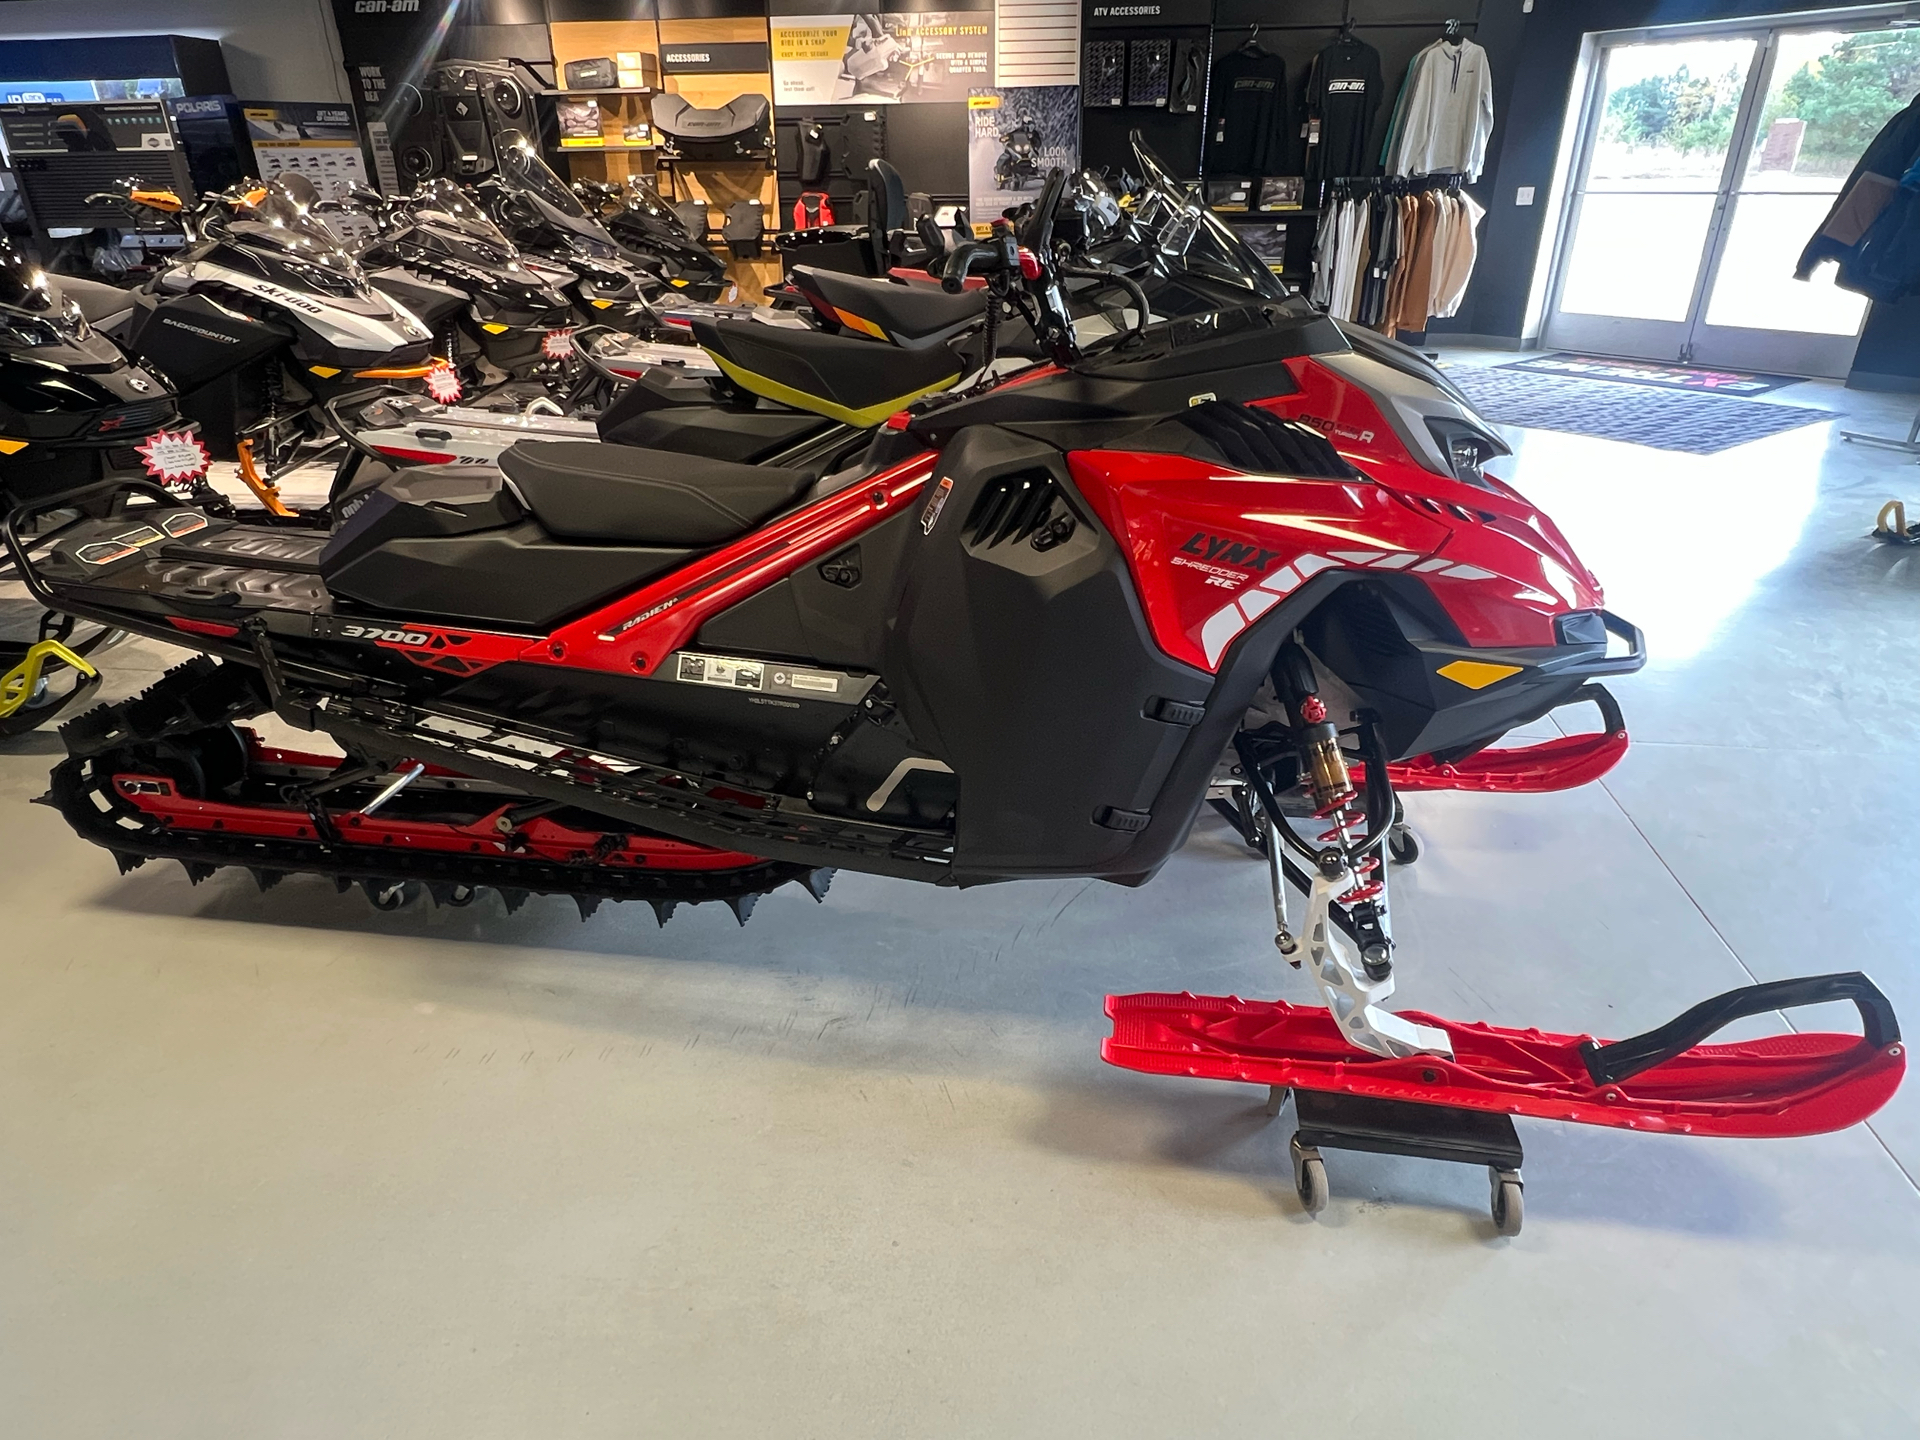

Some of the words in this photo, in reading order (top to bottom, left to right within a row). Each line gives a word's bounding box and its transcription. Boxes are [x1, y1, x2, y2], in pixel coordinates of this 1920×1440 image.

[355, 0, 420, 13] can-am
[1094, 8, 1107, 17] ATV
[1109, 6, 1161, 16] ACCESSORIES
[780, 30, 820, 38] ACCESSORIZE
[916, 27, 957, 36] ACCESSORY
[960, 26, 988, 35] SYSTEM
[666, 53, 711, 63] ACCESSORIES
[359, 66, 382, 78] WORK
[361, 78, 372, 89] TO
[372, 78, 386, 89] THE
[364, 90, 381, 102] BEA
[175, 100, 222, 114] POLARIS
[975, 116, 995, 127] RIDE
[975, 128, 1001, 138] HARD.
[1044, 146, 1067, 157] LOOK
[1031, 158, 1070, 168] SMOOTH.
[252, 284, 324, 314] ski-doo
[163, 318, 241, 344] BACKCOUNTRY
[1358, 430, 1375, 444] R
[1180, 532, 1281, 571] LYNX
[1170, 556, 1249, 581] SHREDDER
[1205, 575, 1240, 590] RE
[340, 625, 428, 645] 3700
